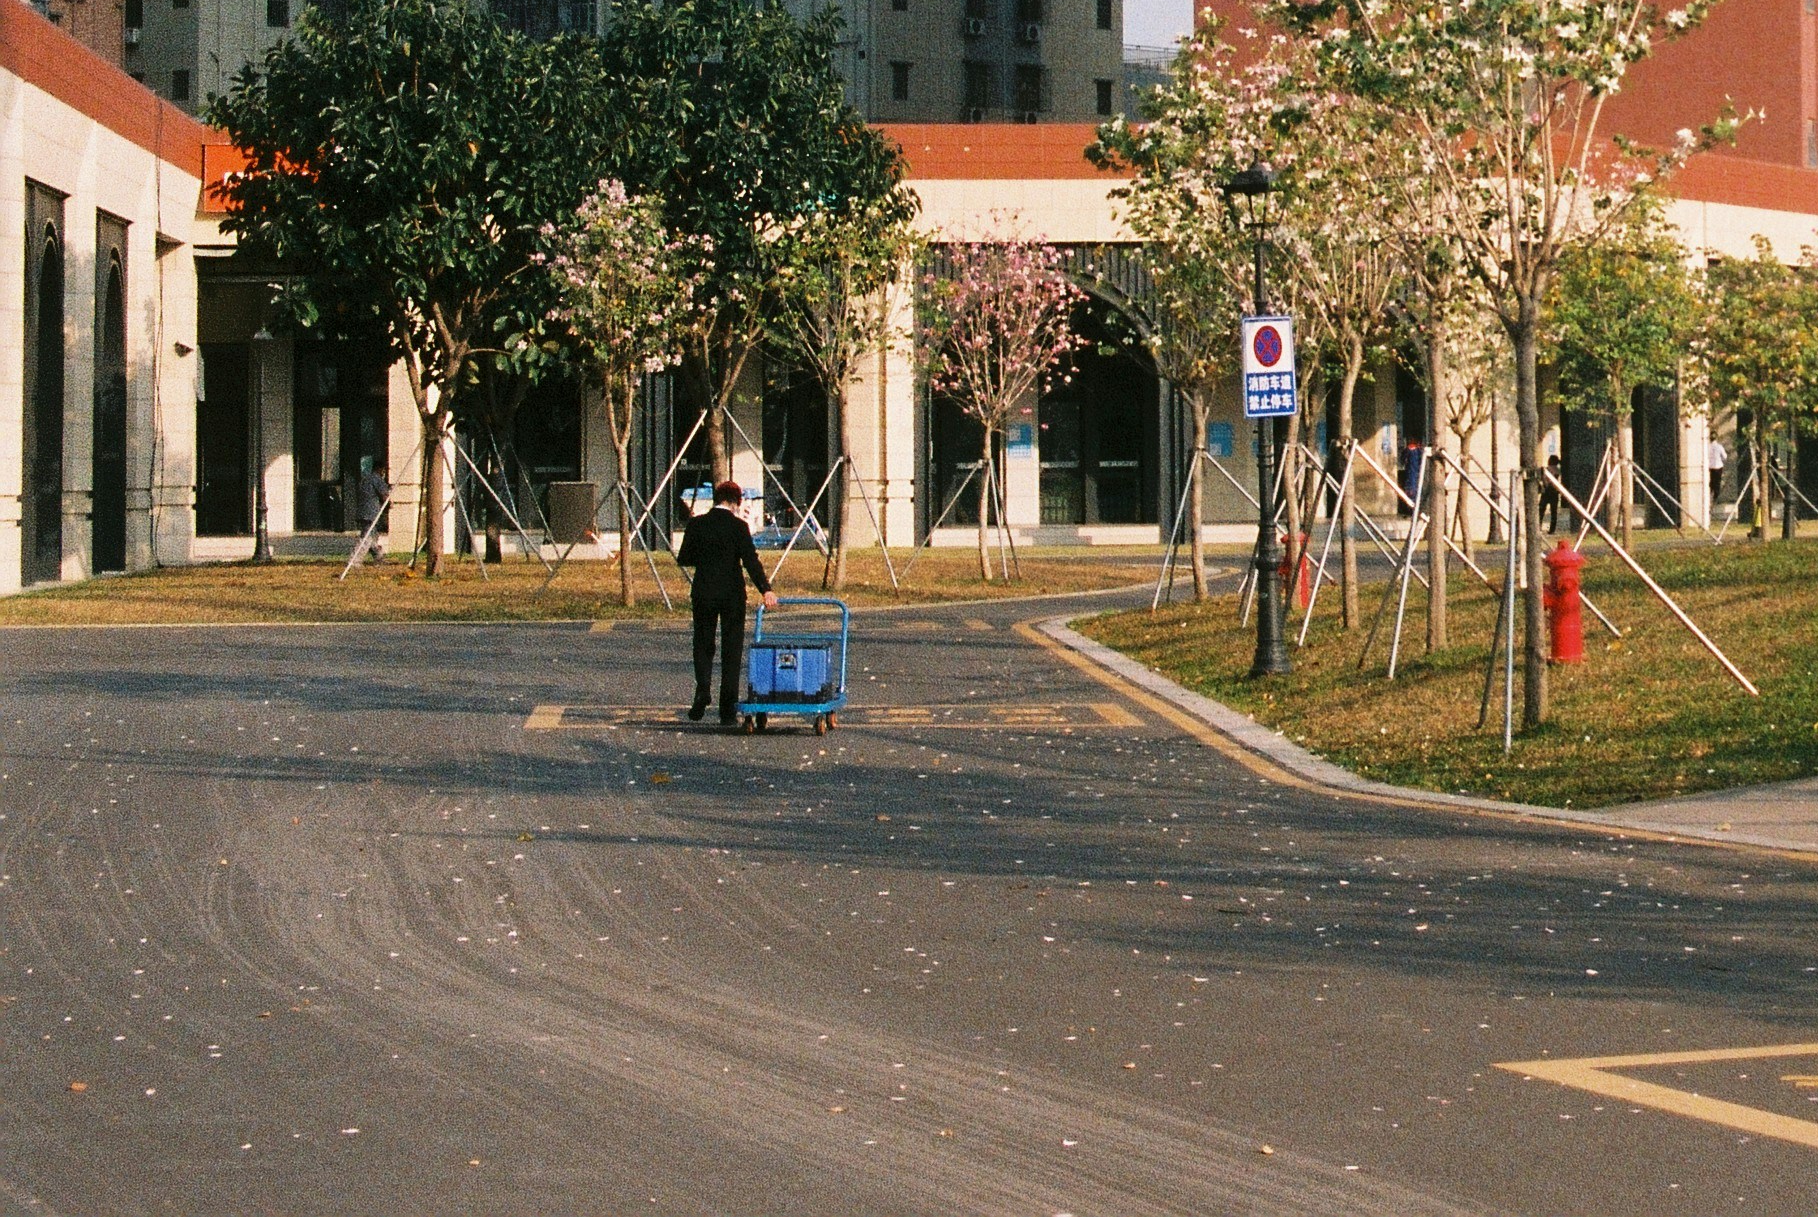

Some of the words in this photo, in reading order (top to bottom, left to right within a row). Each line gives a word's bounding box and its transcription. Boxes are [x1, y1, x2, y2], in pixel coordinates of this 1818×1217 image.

[1249, 374, 1292, 391] 消防车道
[1249, 394, 1292, 411] 禁止停车
